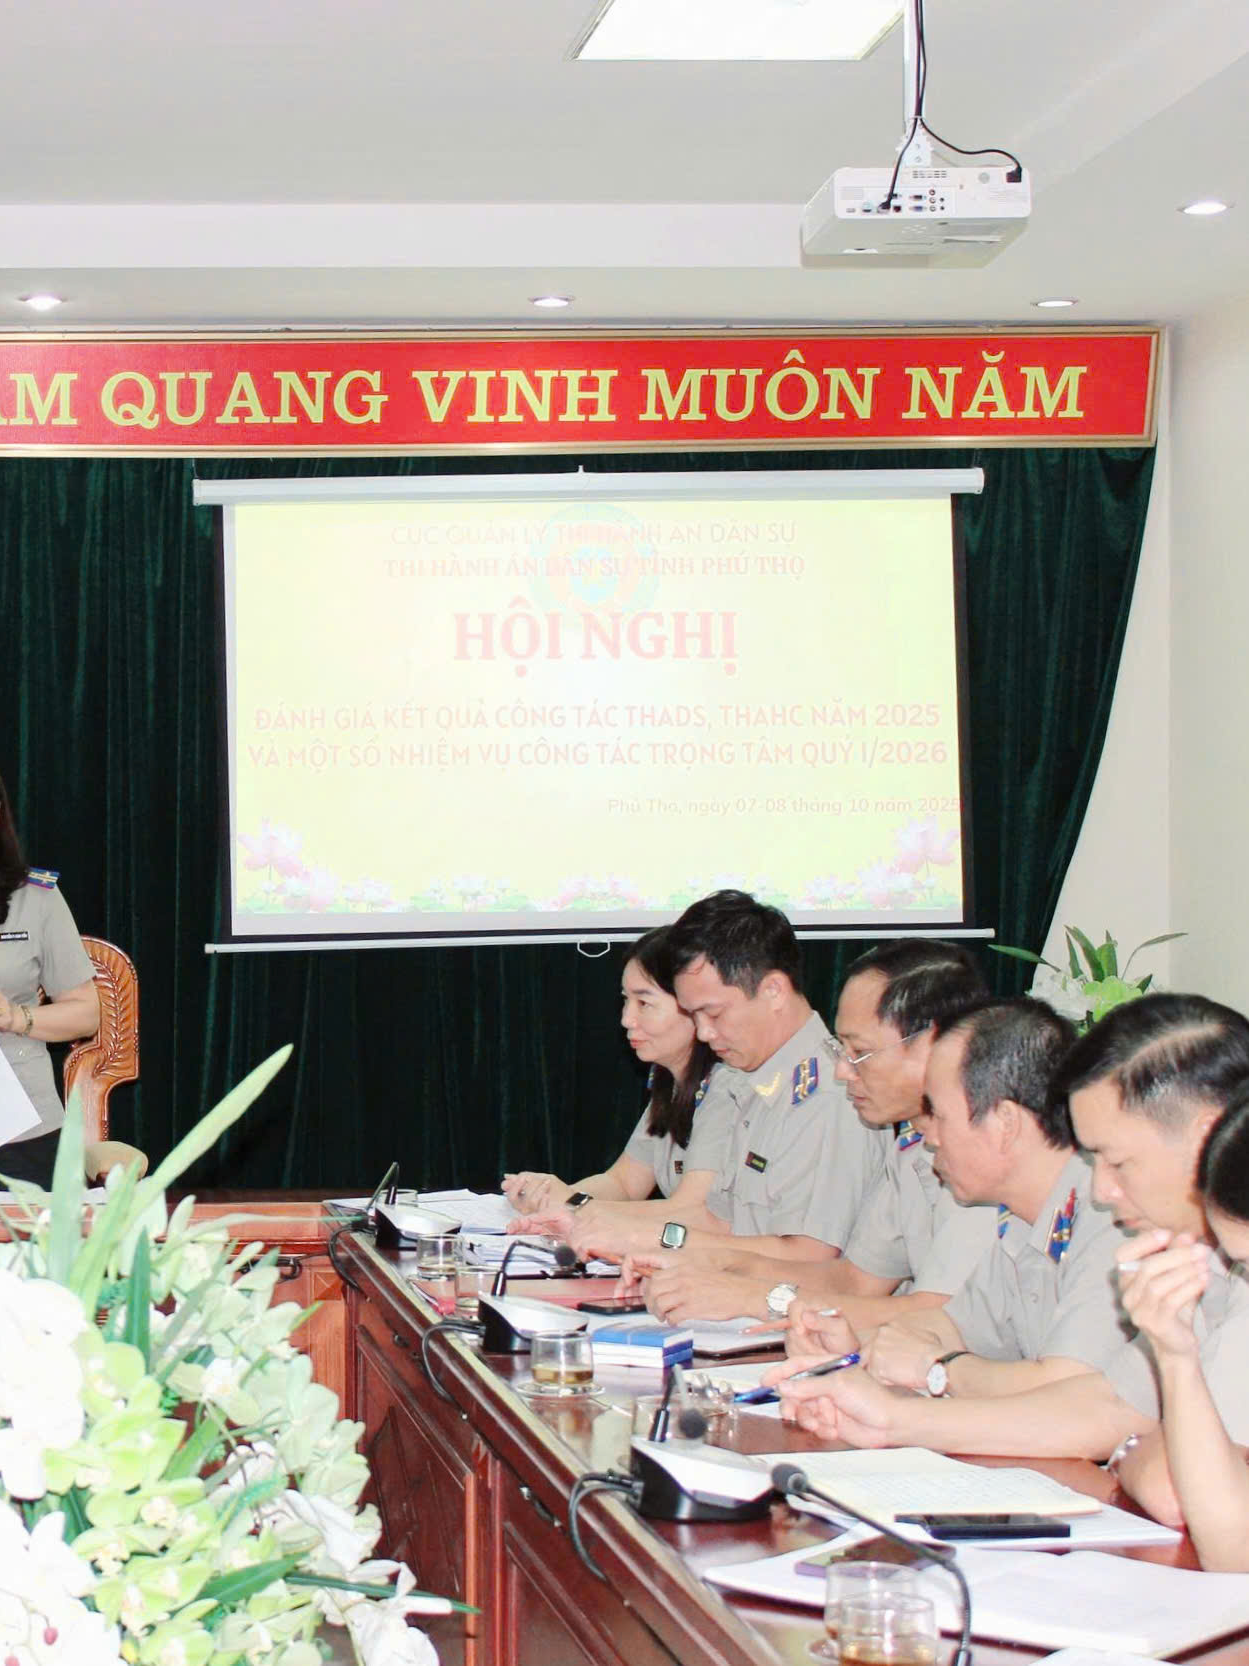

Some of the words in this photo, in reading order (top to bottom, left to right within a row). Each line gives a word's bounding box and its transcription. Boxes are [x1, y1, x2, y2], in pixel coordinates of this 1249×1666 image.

[100, 370, 389, 429] QUANG
[411, 370, 619, 423] VINH
[638, 349, 881, 422] MUÔN
[901, 350, 1088, 419] NĂM
[384, 558, 425, 578] THI
[431, 552, 499, 577] HÀNH
[701, 550, 750, 576] PHÚ
[754, 555, 805, 583] THỌ
[453, 595, 563, 678] HỘI
[580, 610, 738, 677] NGHỊ
[254, 701, 326, 730] ĐÁNH
[333, 701, 376, 730] GIÁ
[384, 698, 428, 729] KẾT
[436, 698, 488, 732] QUẢ
[495, 698, 567, 728] CÔNG
[571, 698, 619, 728] TÁC
[624, 704, 712, 735] THADS,
[718, 704, 803, 728] THAHC
[811, 697, 867, 728] NĂM
[875, 703, 941, 728] 2025
[248, 738, 280, 767] VÀ
[288, 738, 342, 774] MỘT
[350, 735, 382, 767] SỐ
[390, 737, 470, 775] NHIỆM
[478, 744, 510, 774] VỤ
[517, 736, 590, 766] CÔNG
[596, 737, 641, 766] TÁC
[648, 742, 735, 775] TRỌNG
[742, 736, 794, 766] TÂM
[801, 735, 854, 768] QUÝ
[861, 736, 947, 768] I/2026
[735, 798, 787, 814] 07-08
[791, 797, 842, 817] tháng
[850, 798, 870, 814] 10
